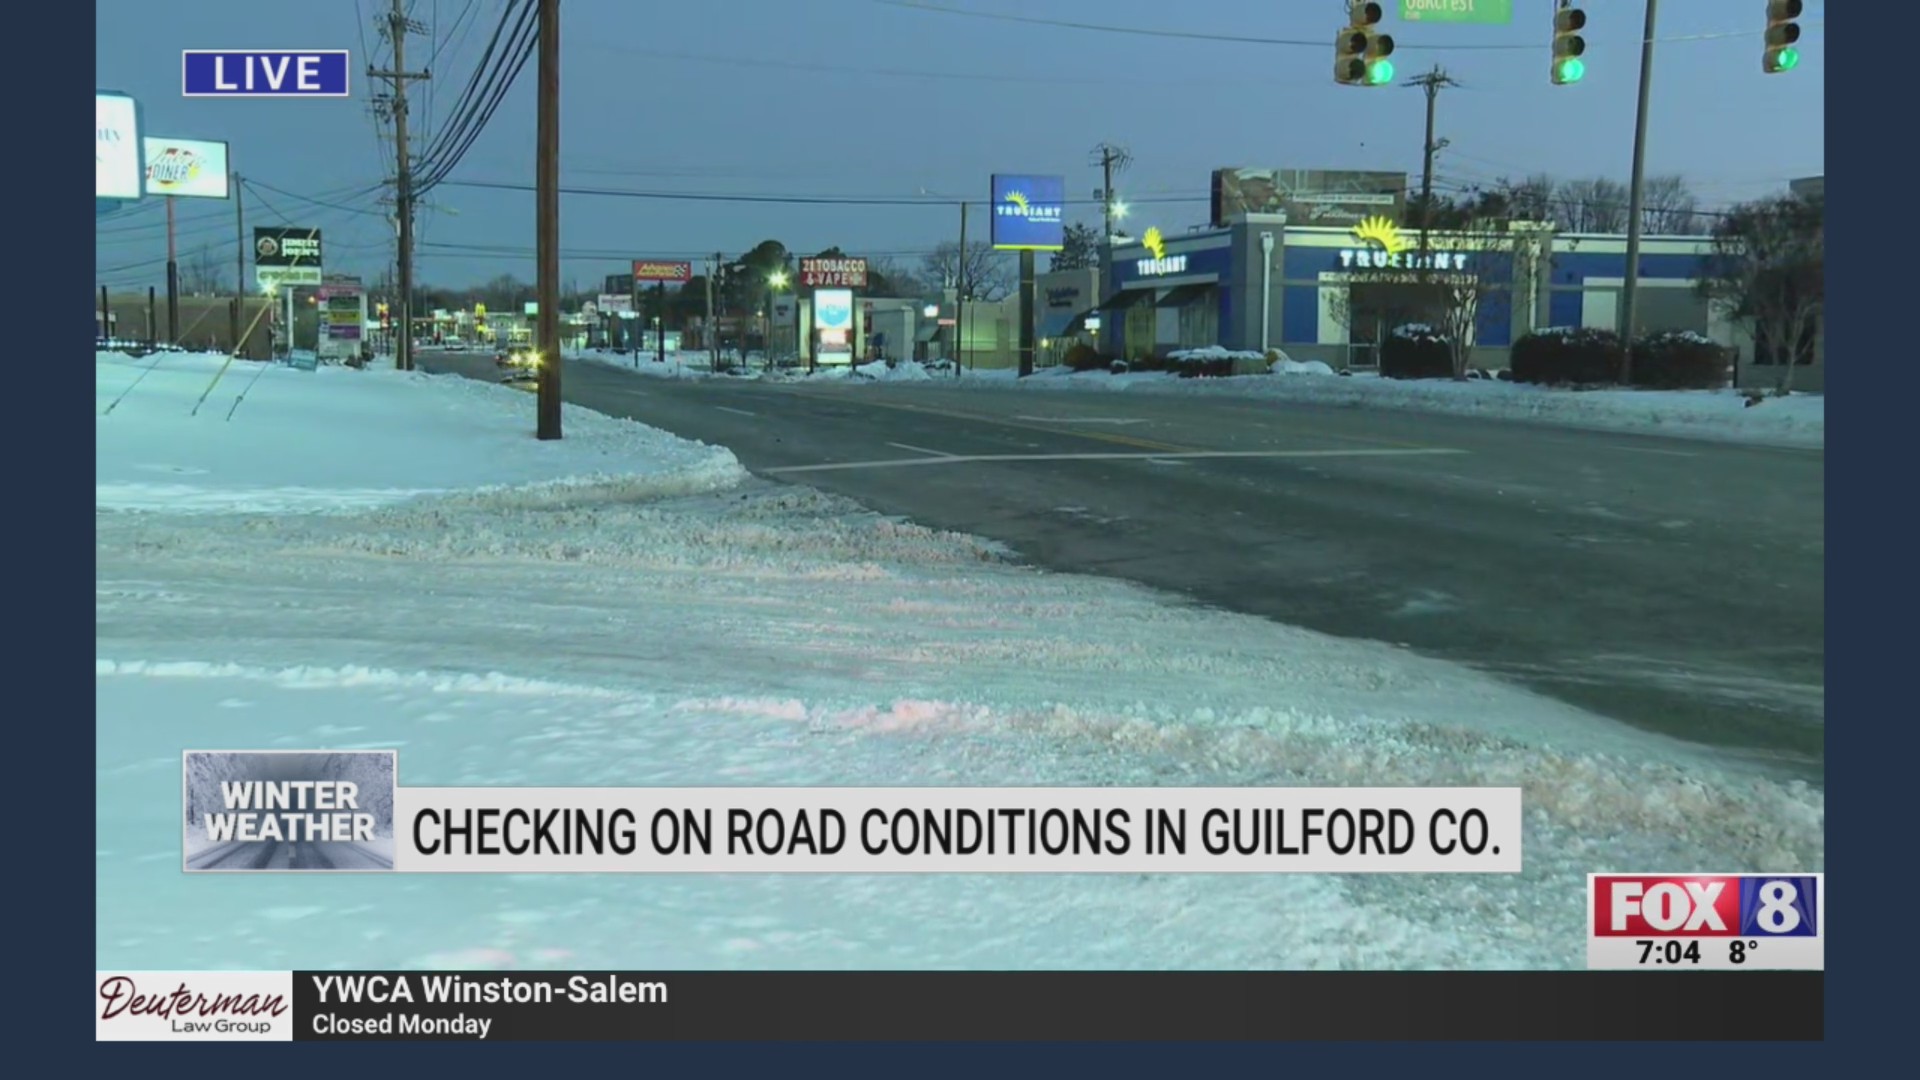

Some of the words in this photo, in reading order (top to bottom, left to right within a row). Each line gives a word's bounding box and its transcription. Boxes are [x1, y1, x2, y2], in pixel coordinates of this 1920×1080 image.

[153, 163, 189, 181] DINER
[816, 259, 866, 271] TOBACCO
[818, 273, 849, 285] VAPE
